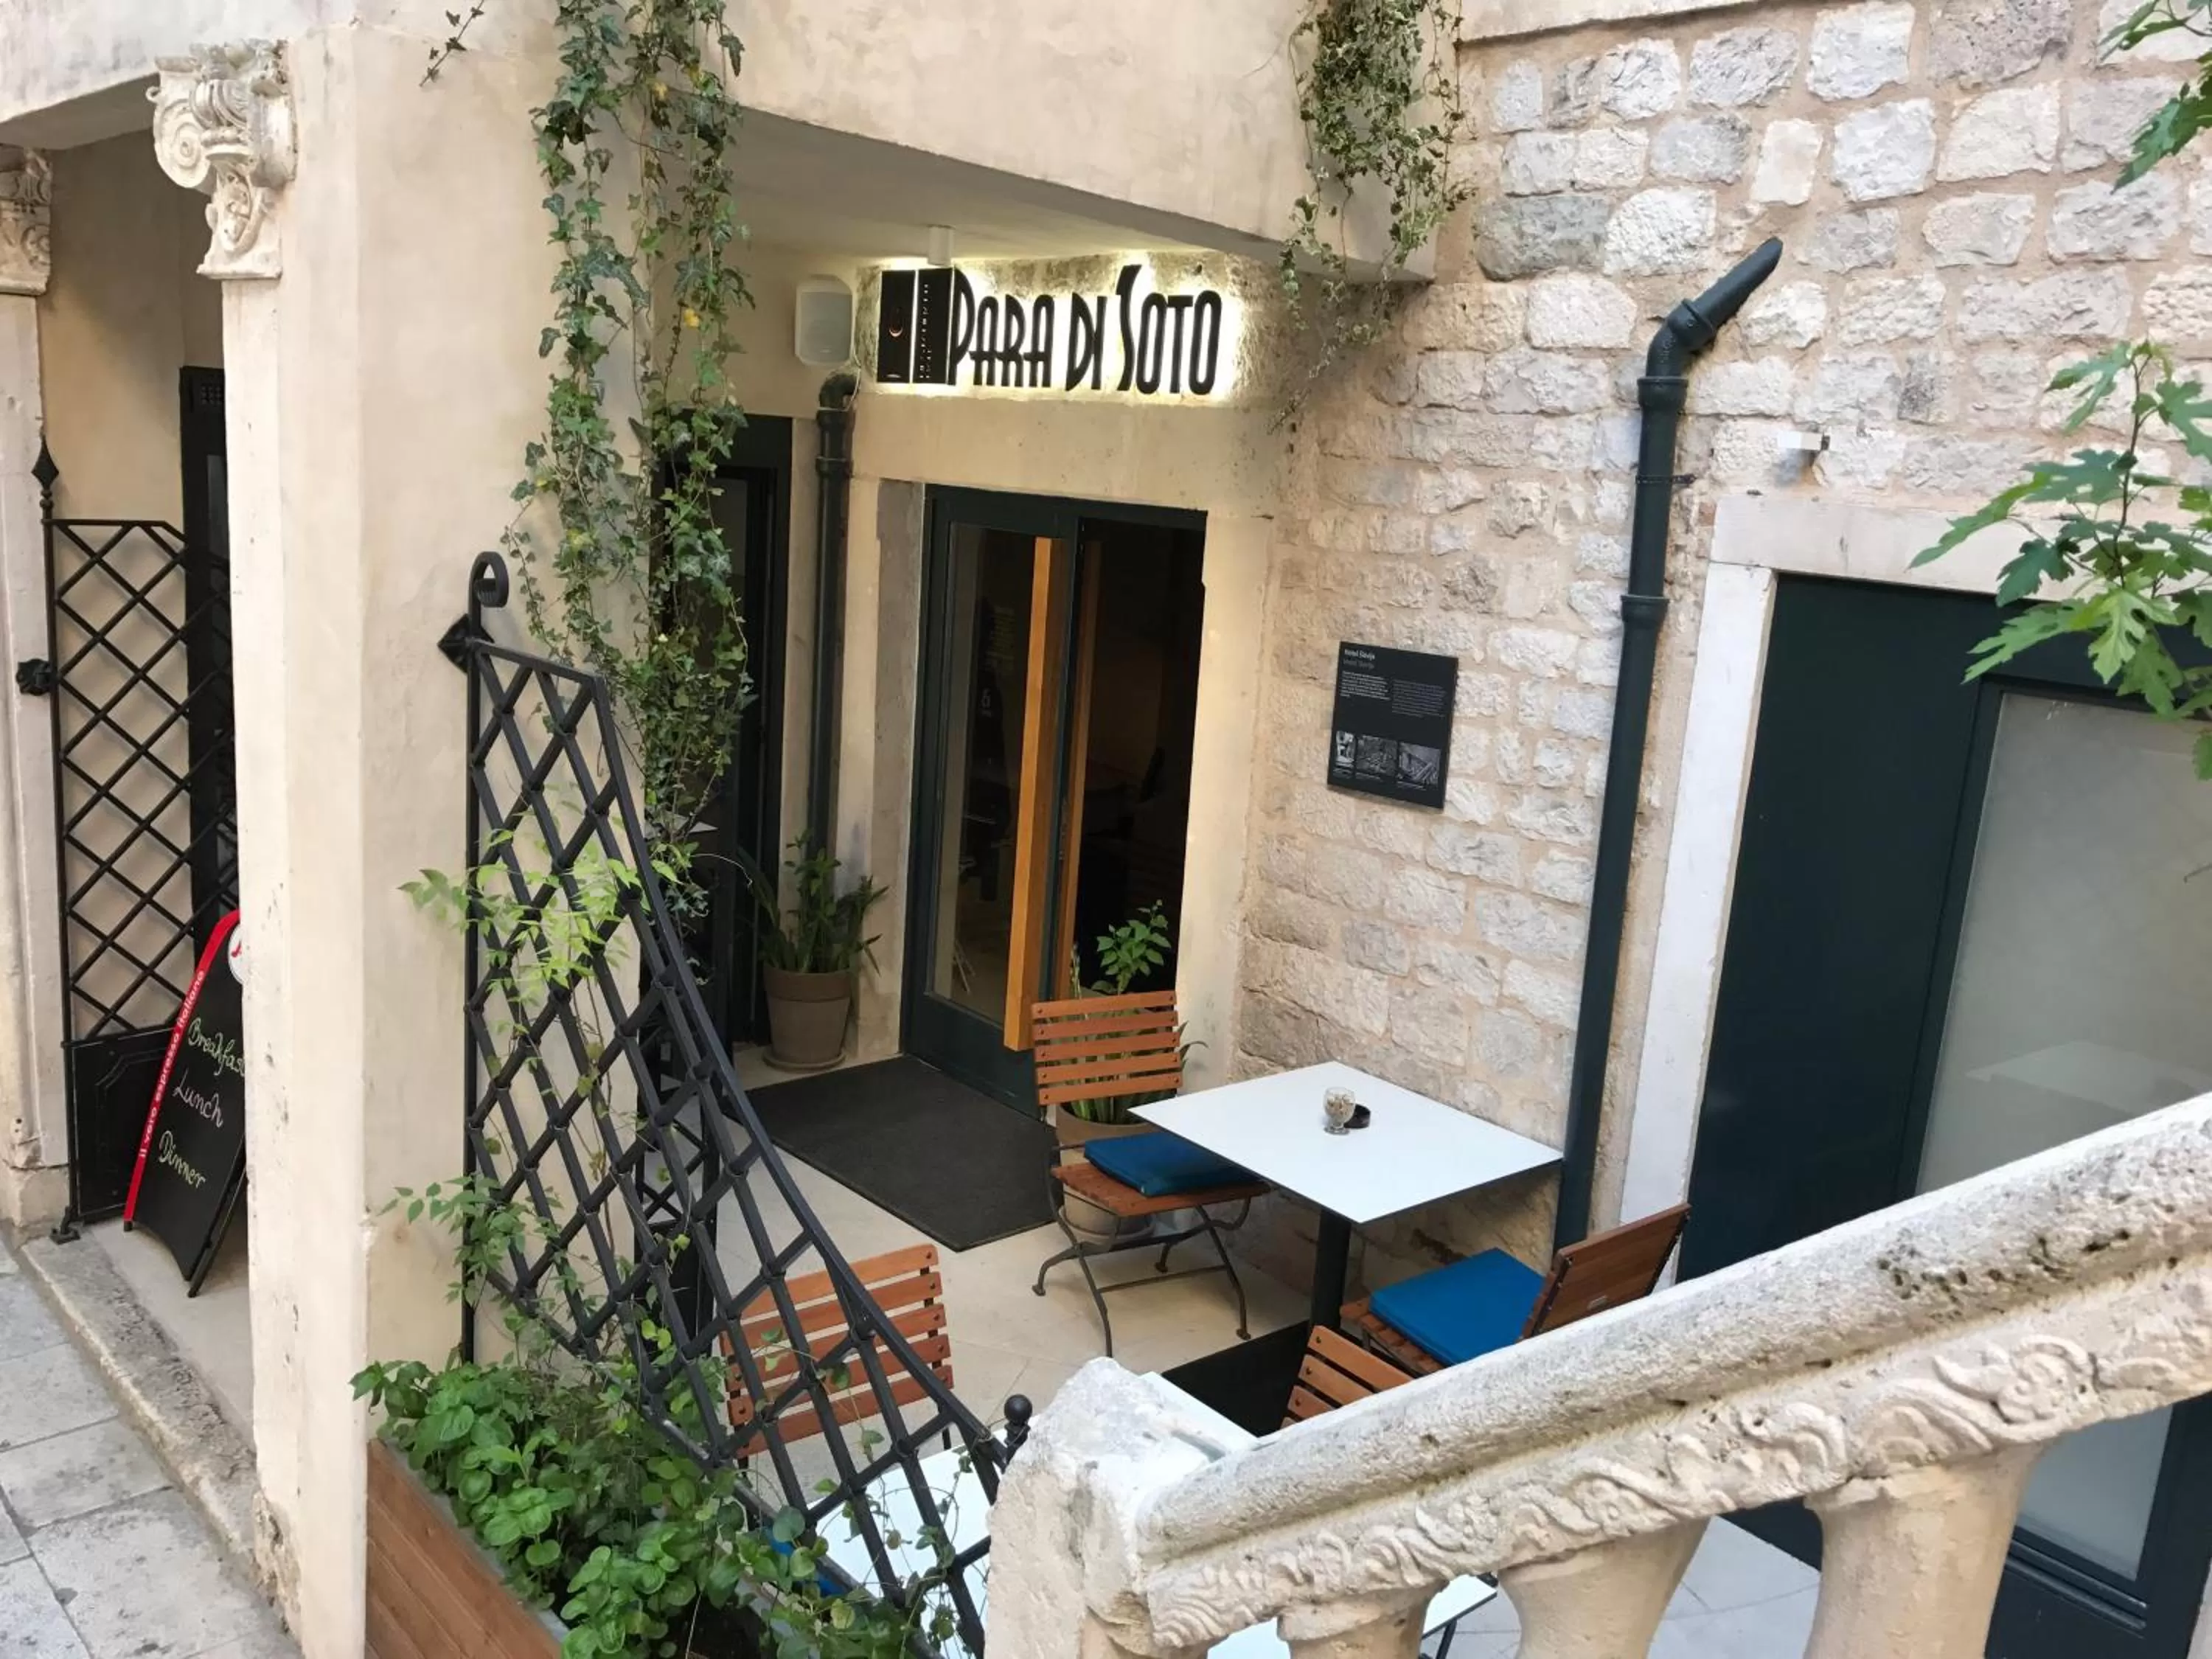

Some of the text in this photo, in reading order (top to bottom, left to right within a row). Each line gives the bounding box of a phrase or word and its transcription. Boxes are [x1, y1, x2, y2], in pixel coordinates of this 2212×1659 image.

[1065, 292, 1107, 392] DI
[188, 1017, 245, 1077] Breakfas
[173, 1066, 223, 1127] Lunch
[159, 1130, 206, 1188] Dinner
